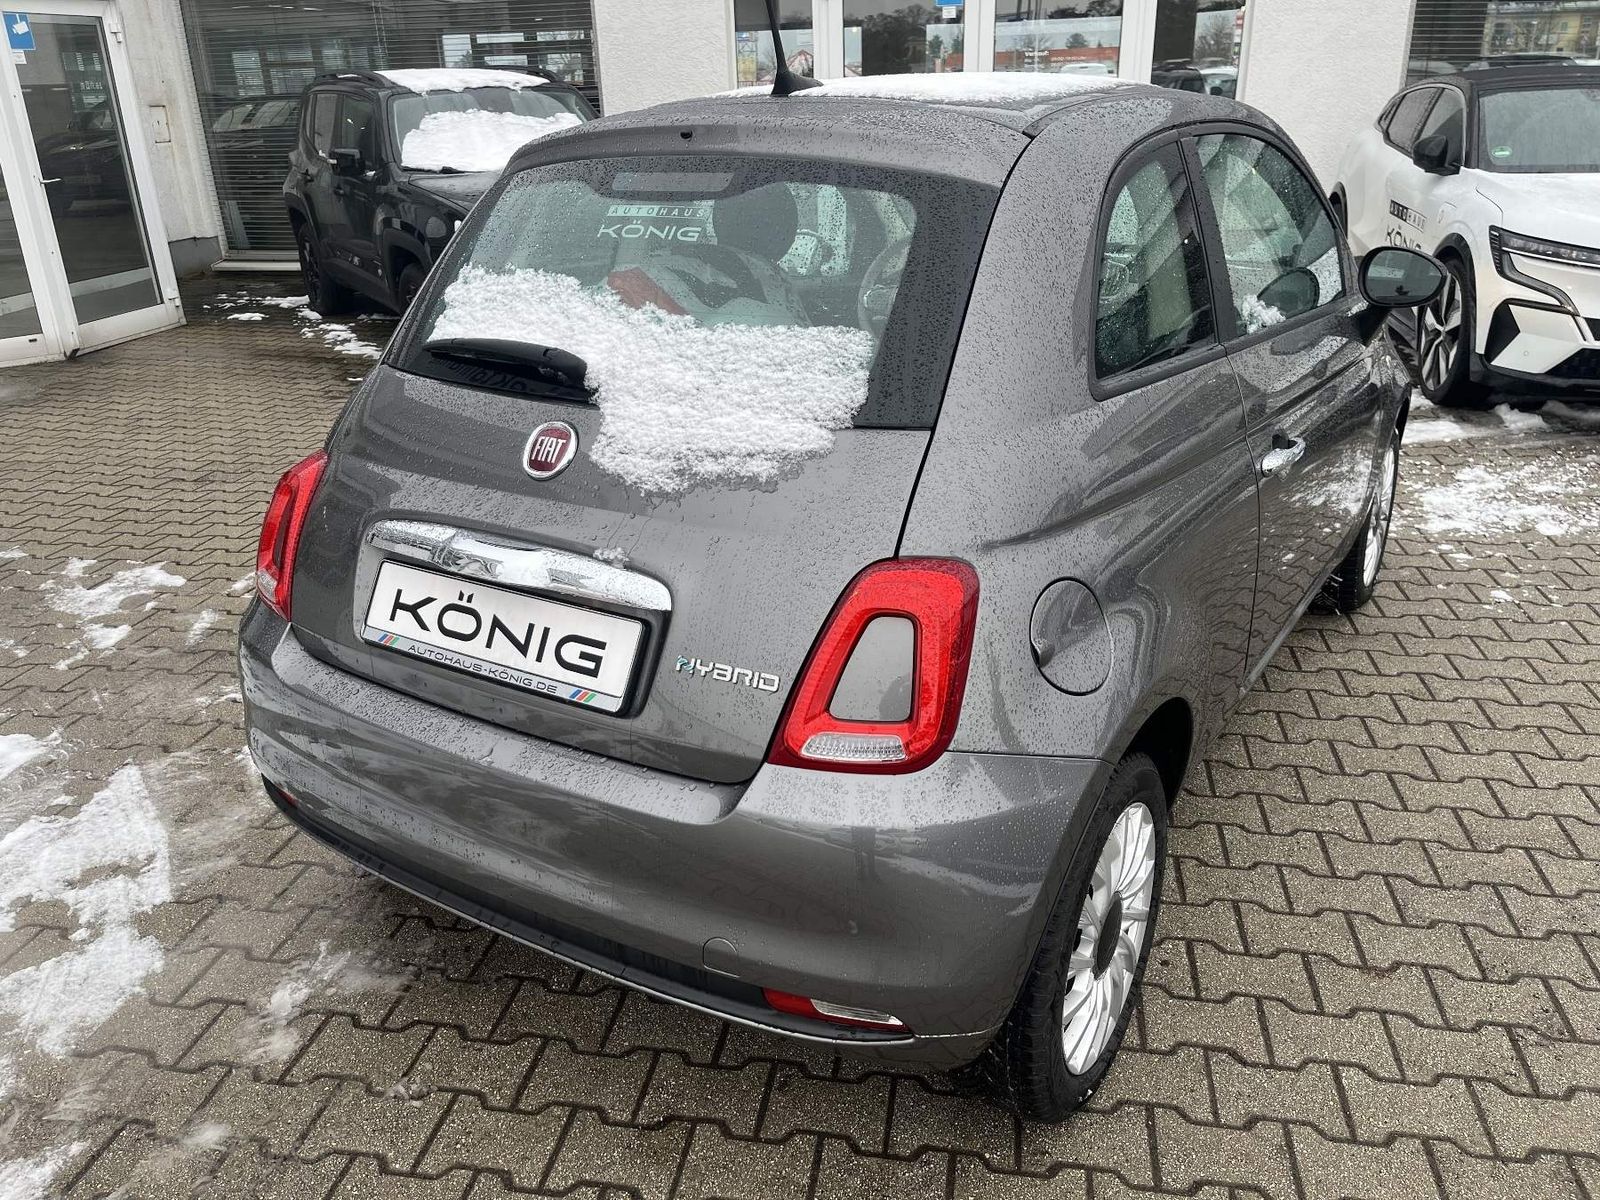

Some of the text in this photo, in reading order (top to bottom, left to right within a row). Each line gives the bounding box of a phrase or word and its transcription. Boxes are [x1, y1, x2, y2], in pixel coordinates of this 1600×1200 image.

[611, 206, 705, 218] AUTOHAUS
[597, 219, 702, 242] KÖNIG
[531, 436, 567, 463] FIAT
[389, 588, 607, 678] KÖNIG
[407, 644, 558, 694] AUTOHAUS-KÖNIG.DE
[675, 655, 780, 692] HYBRID
